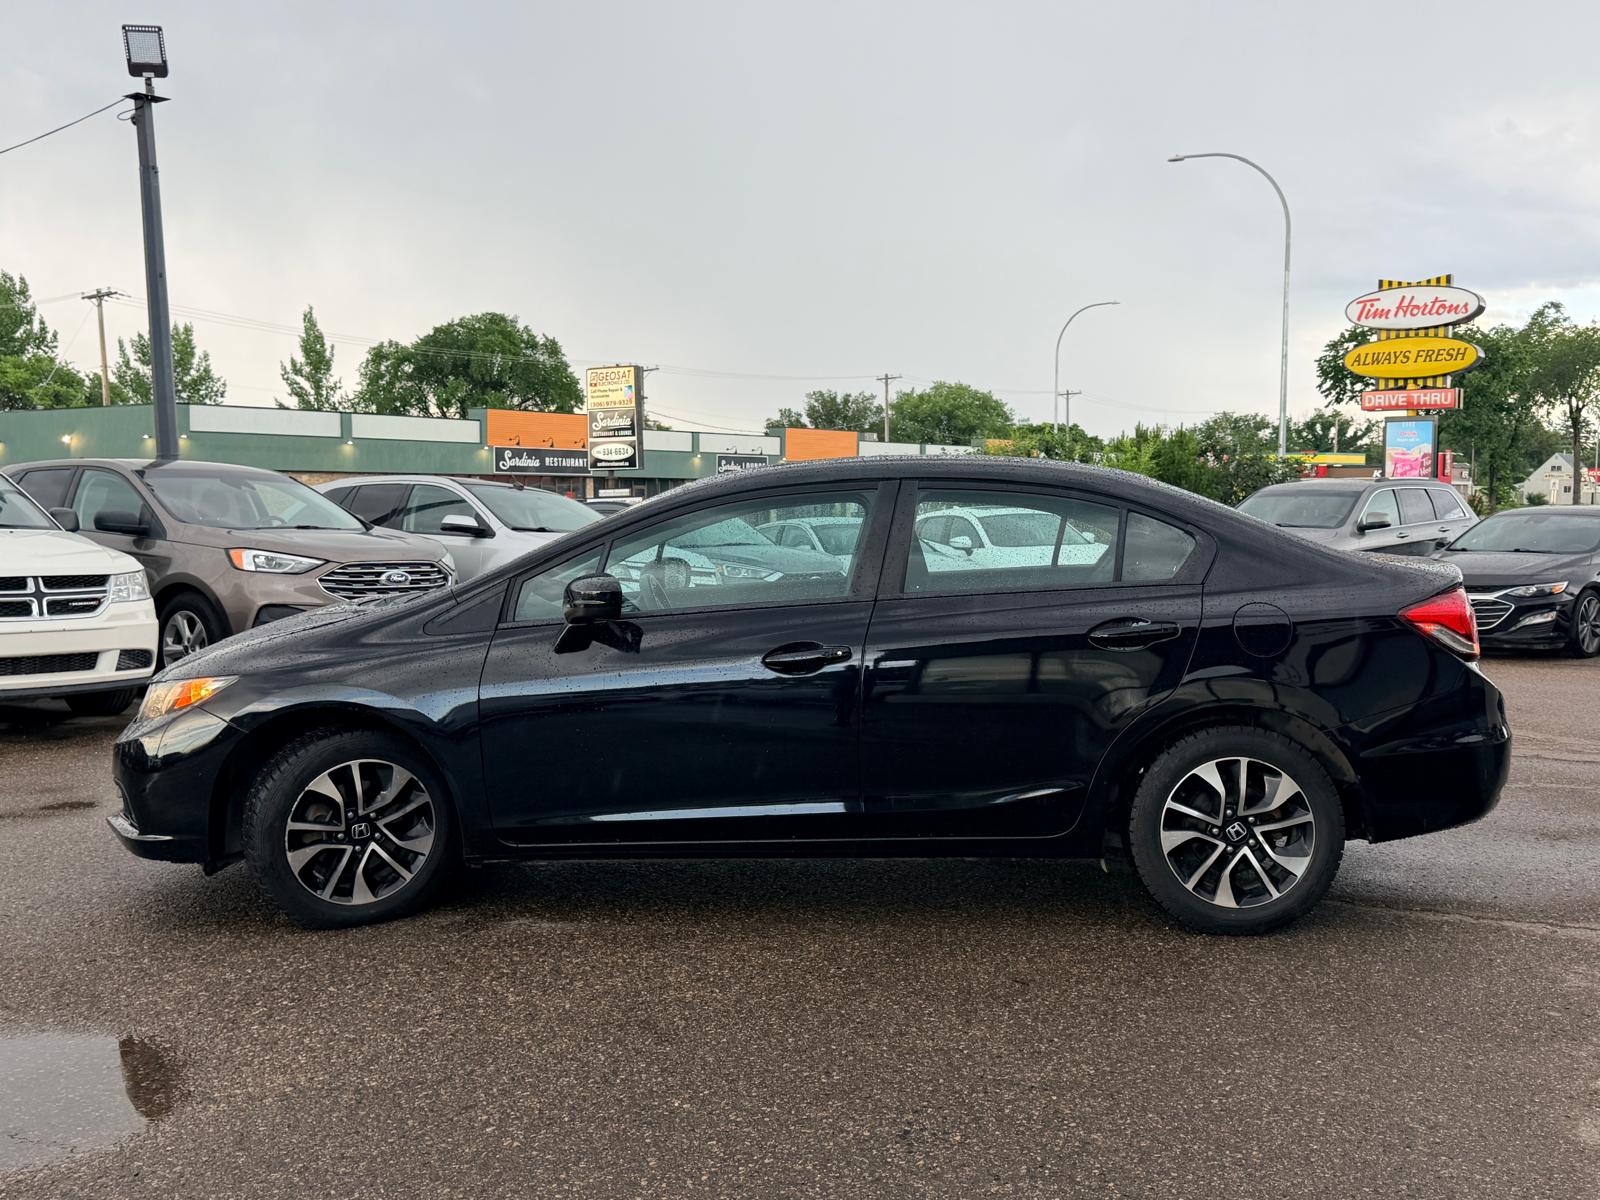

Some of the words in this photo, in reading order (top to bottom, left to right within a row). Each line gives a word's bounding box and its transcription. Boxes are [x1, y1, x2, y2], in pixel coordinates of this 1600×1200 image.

[1356, 298, 1391, 322] Tim
[1394, 295, 1470, 318] Hortons
[1351, 350, 1411, 367] ALWAYS
[1413, 347, 1468, 363] FRESH
[599, 370, 632, 381] GEOSAT
[1365, 393, 1408, 407] DRIVE
[1410, 391, 1452, 405] THRU
[592, 411, 632, 431] Sardinia
[499, 450, 541, 470] Sardinia
[545, 456, 588, 467] RESTAURANT
